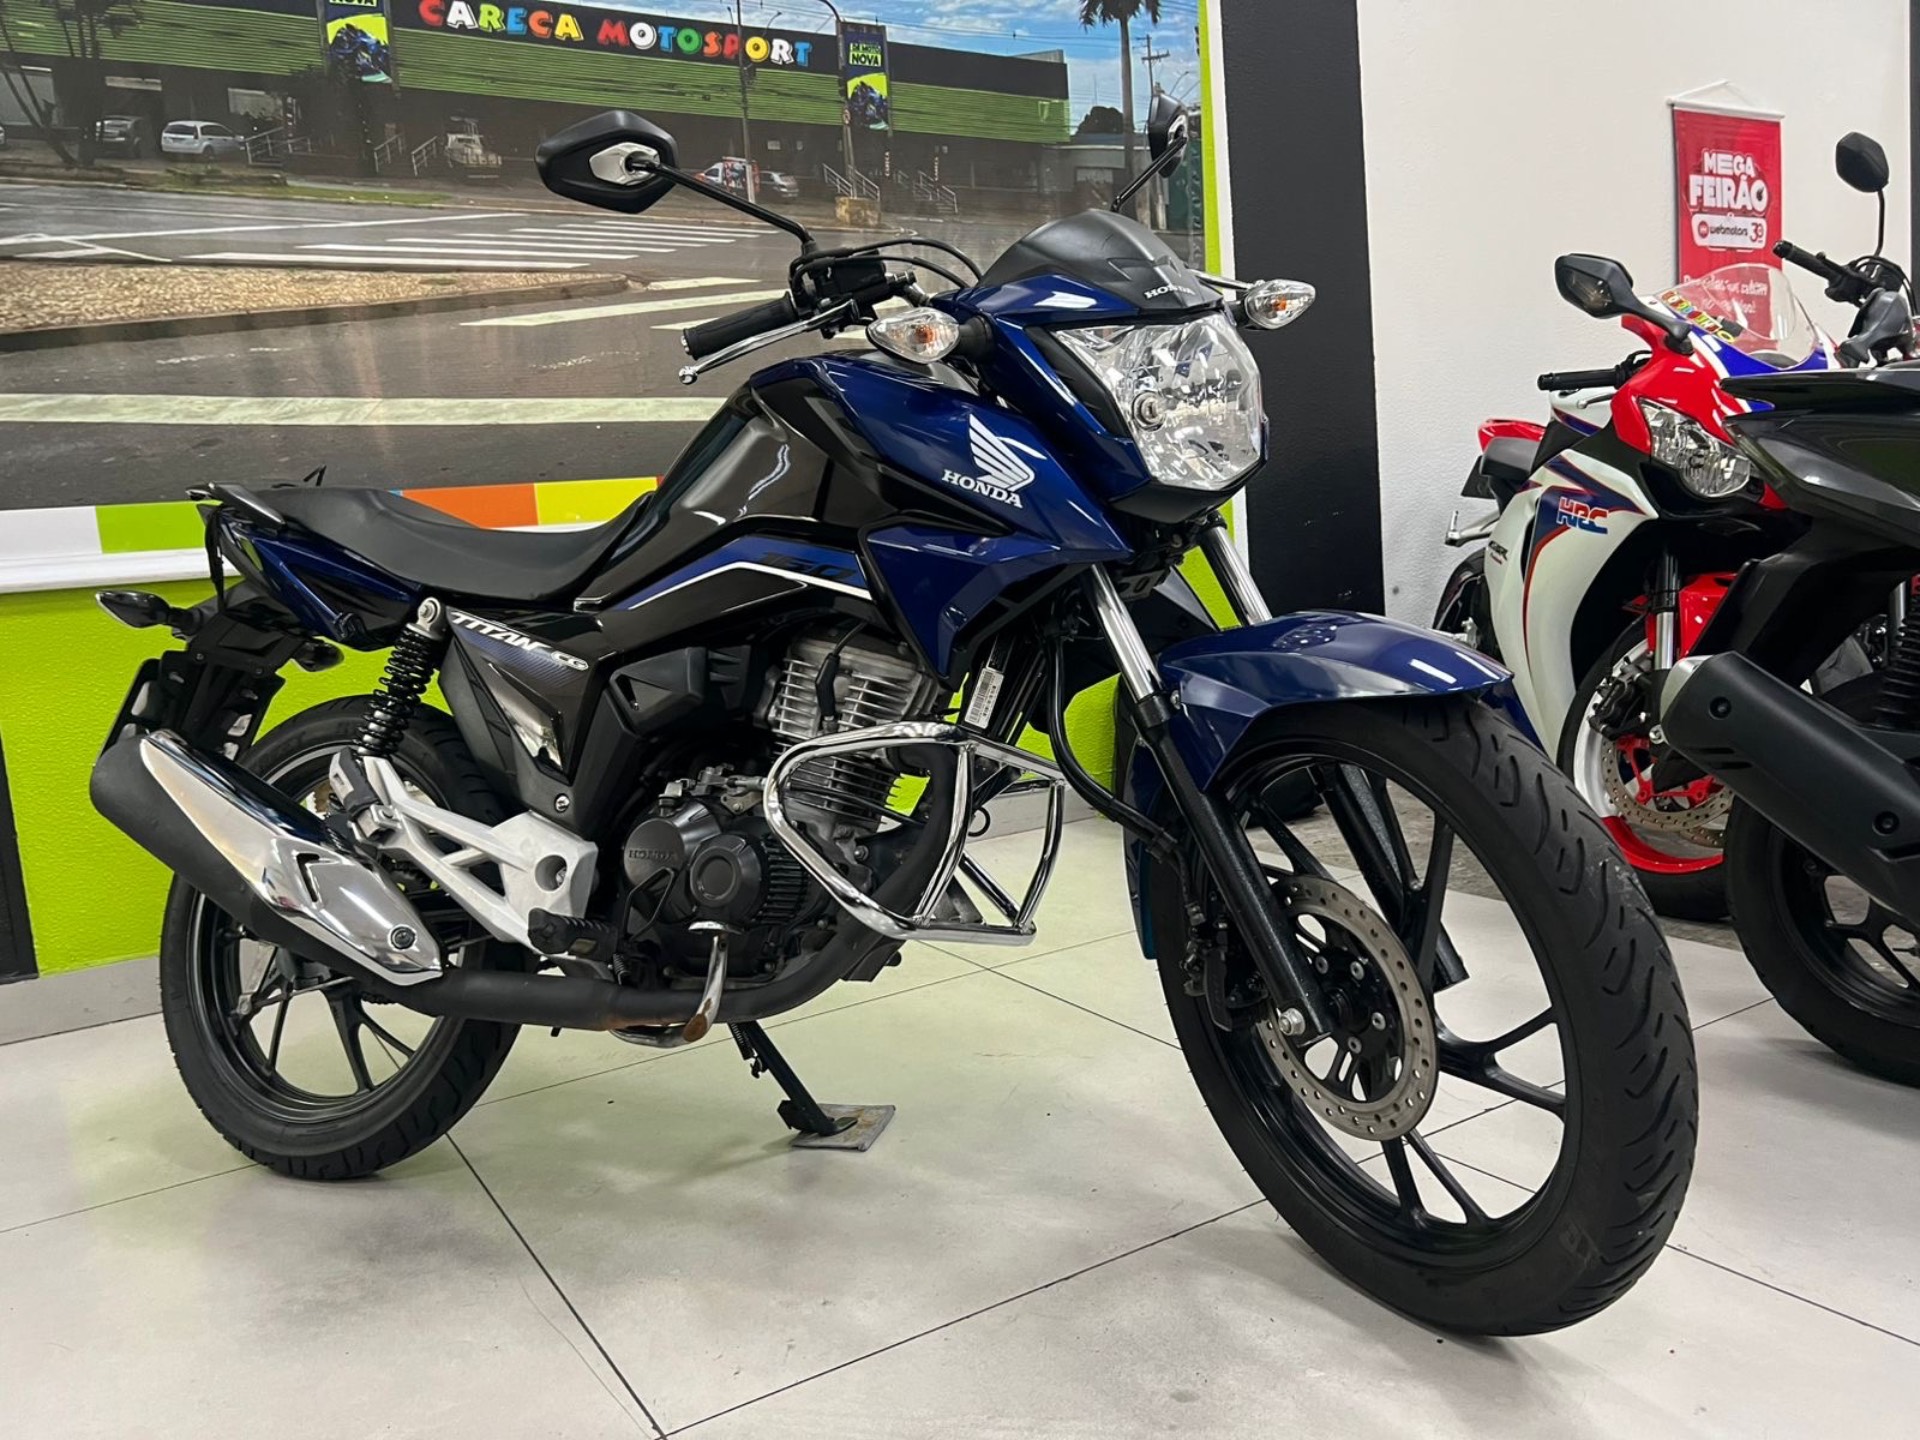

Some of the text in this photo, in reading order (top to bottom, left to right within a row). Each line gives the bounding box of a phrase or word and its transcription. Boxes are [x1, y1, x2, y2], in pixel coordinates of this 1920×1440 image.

[418, 0, 812, 67] CARECA MOTOSPORT
[851, 53, 880, 66] NOVA
[1703, 151, 1756, 178] MEGA
[1689, 173, 1768, 213] FEIRÃO
[942, 469, 1023, 509] HONDA
[1556, 496, 1609, 535] HRC
[450, 611, 553, 651] TITAN
